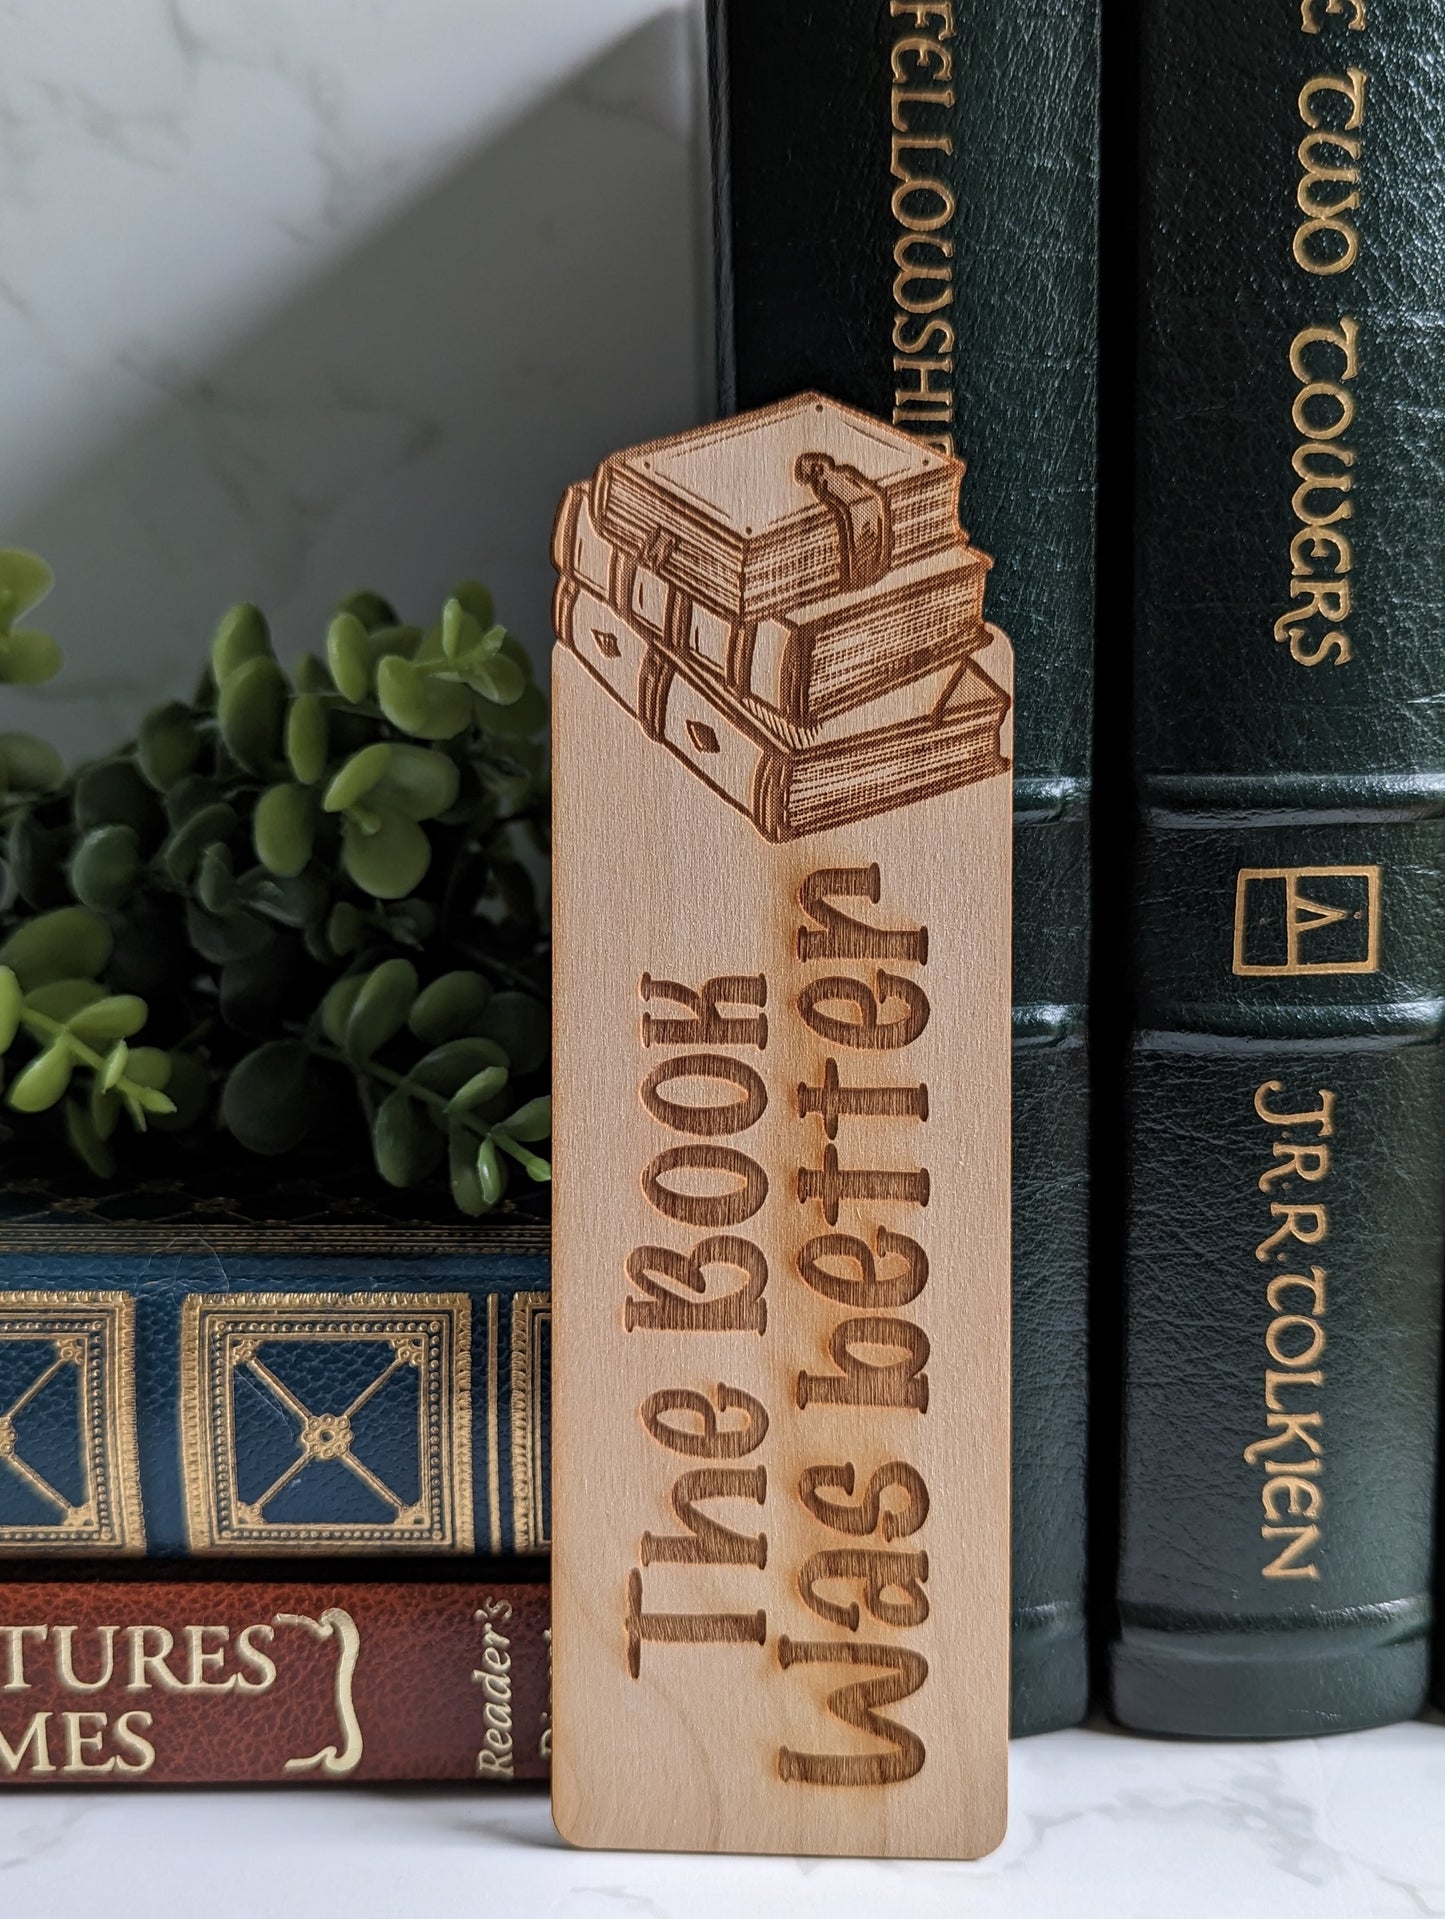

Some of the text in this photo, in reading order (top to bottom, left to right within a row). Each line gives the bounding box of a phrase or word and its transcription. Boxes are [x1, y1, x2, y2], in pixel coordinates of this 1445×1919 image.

[1293, 67, 1368, 276] TWO
[1274, 314, 1360, 668] TOWERS
[796, 861, 930, 1416] better
[622, 1380, 770, 1679] The
[1244, 1265, 1328, 1582] TOLKIEN
[473, 1596, 514, 1779] Reader's
